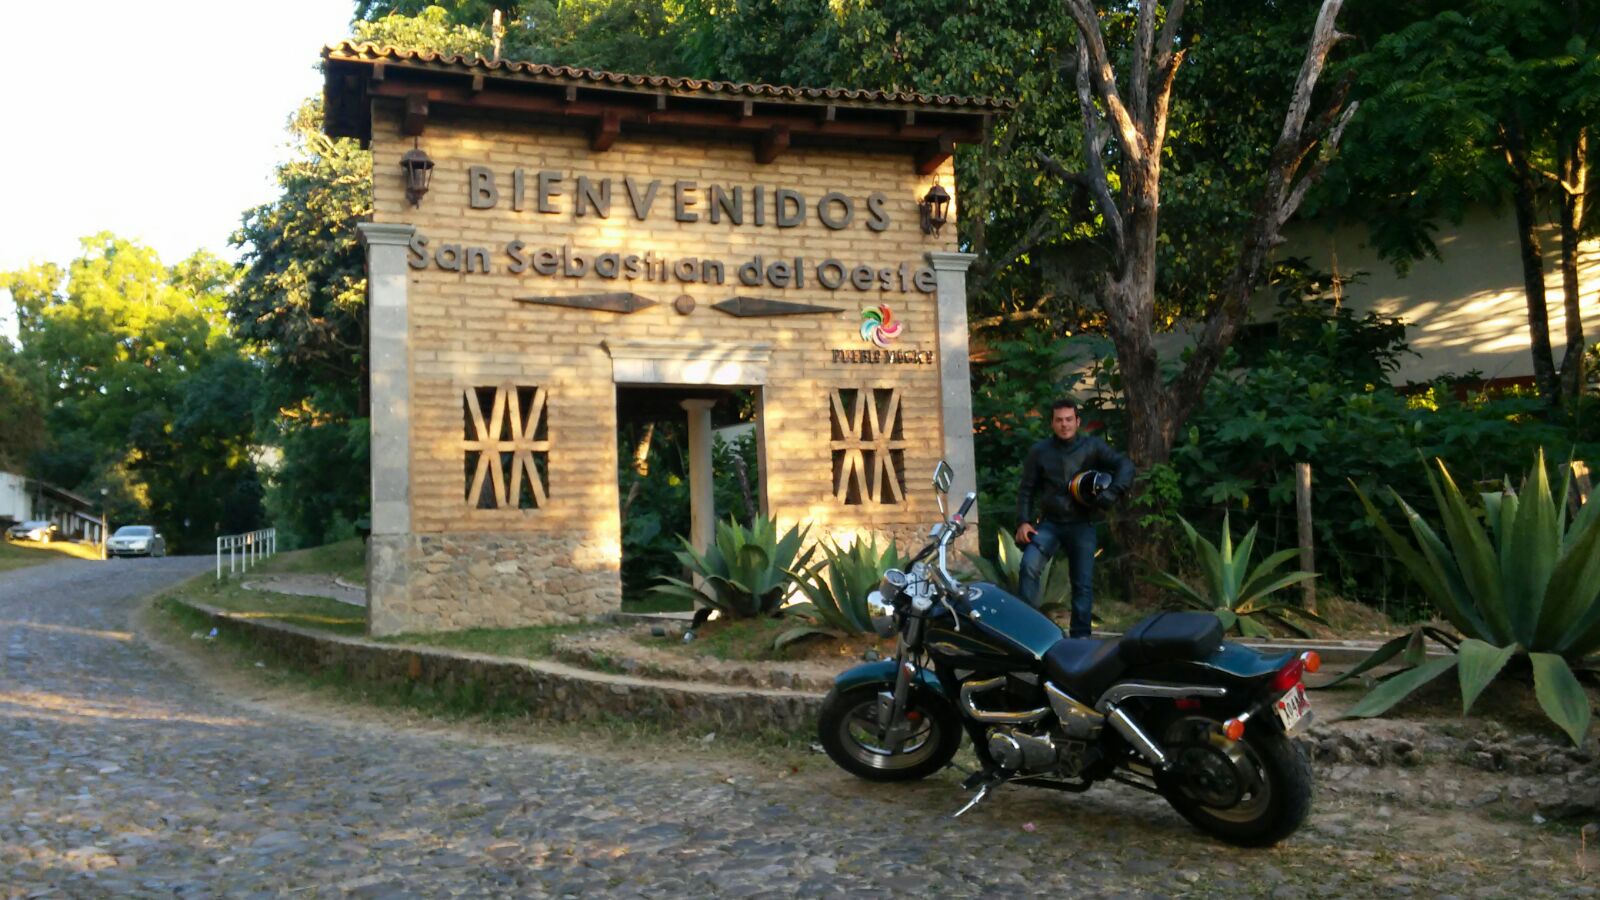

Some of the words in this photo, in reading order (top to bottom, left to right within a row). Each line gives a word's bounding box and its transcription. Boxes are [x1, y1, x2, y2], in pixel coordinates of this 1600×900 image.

[469, 165, 890, 232] BIENVENIDOS
[408, 233, 491, 273] San
[738, 254, 804, 289] del
[816, 257, 938, 294] Oeste
